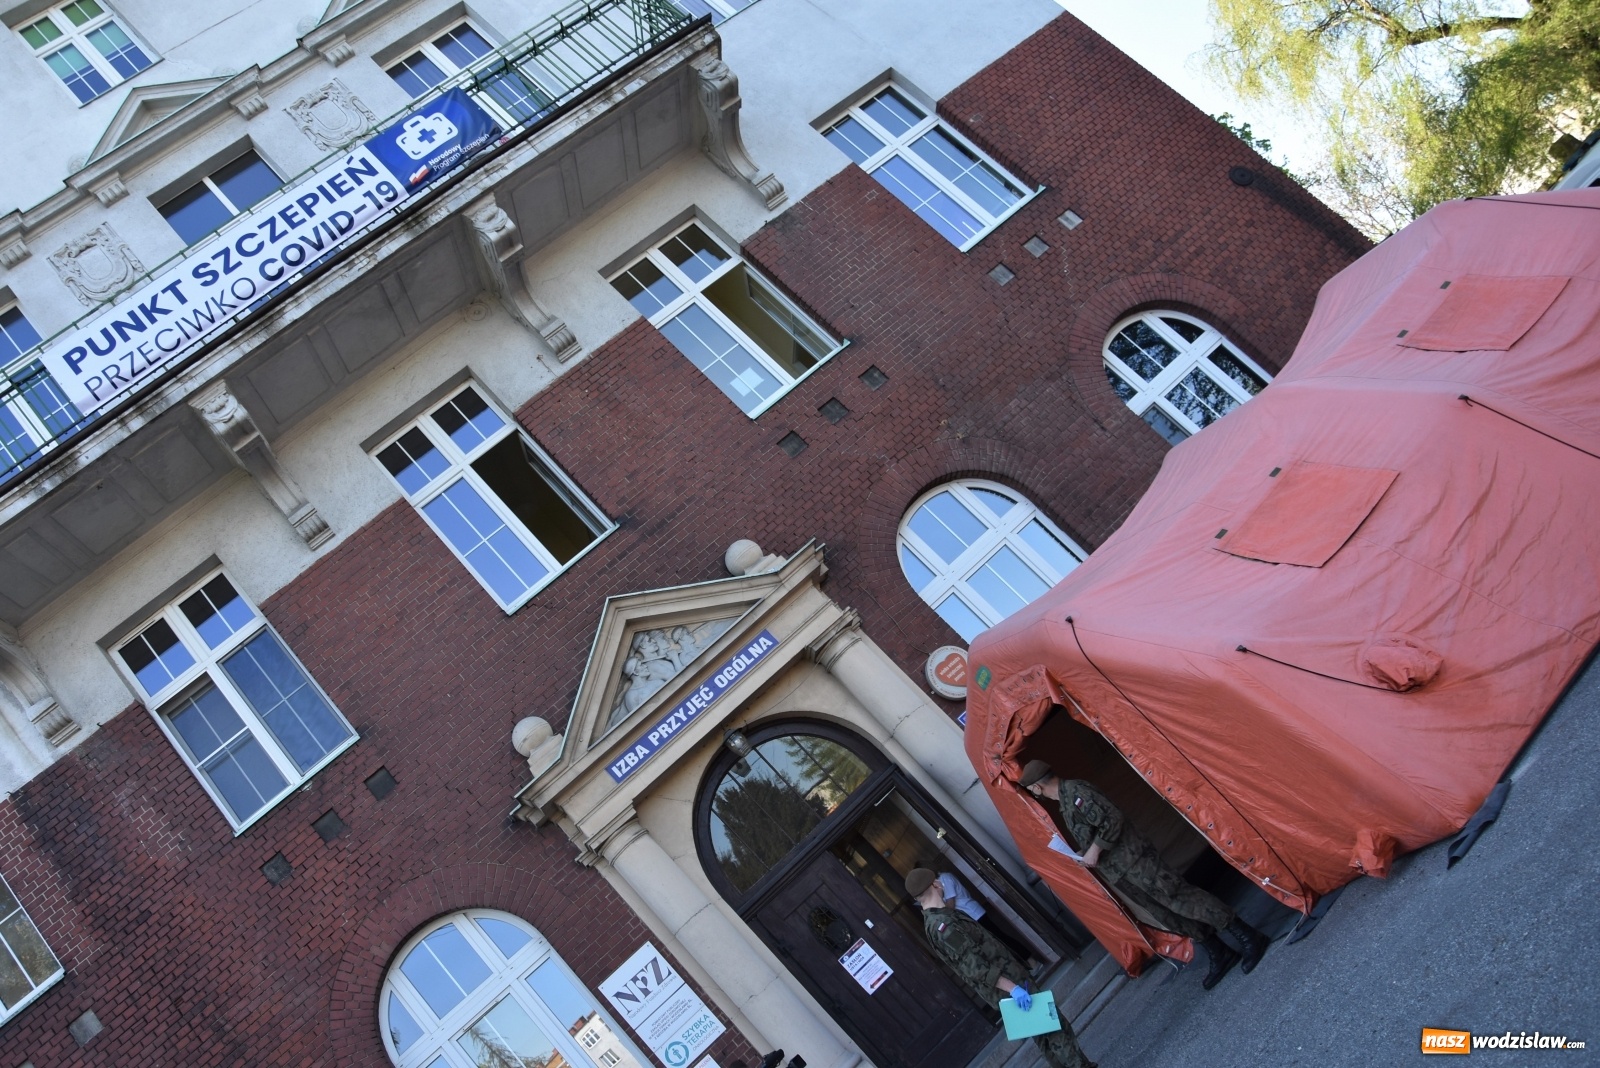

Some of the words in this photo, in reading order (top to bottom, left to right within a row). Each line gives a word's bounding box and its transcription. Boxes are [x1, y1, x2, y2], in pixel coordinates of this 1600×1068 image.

[428, 143, 462, 166] Narodowy
[433, 153, 461, 172] Program
[62, 278, 189, 376] PUNKT
[191, 155, 379, 287] SZCZEPIEŃ
[83, 277, 257, 402] PRZECIWKO
[258, 180, 399, 282] COVID-19
[611, 744, 650, 778] IZBA
[647, 685, 714, 747] PRZYJĘĆ
[713, 636, 774, 689] OGÓLNA
[611, 956, 673, 1015] NFZ
[681, 1013, 710, 1041] SZYBKA
[687, 1020, 716, 1046] TERAPIA
